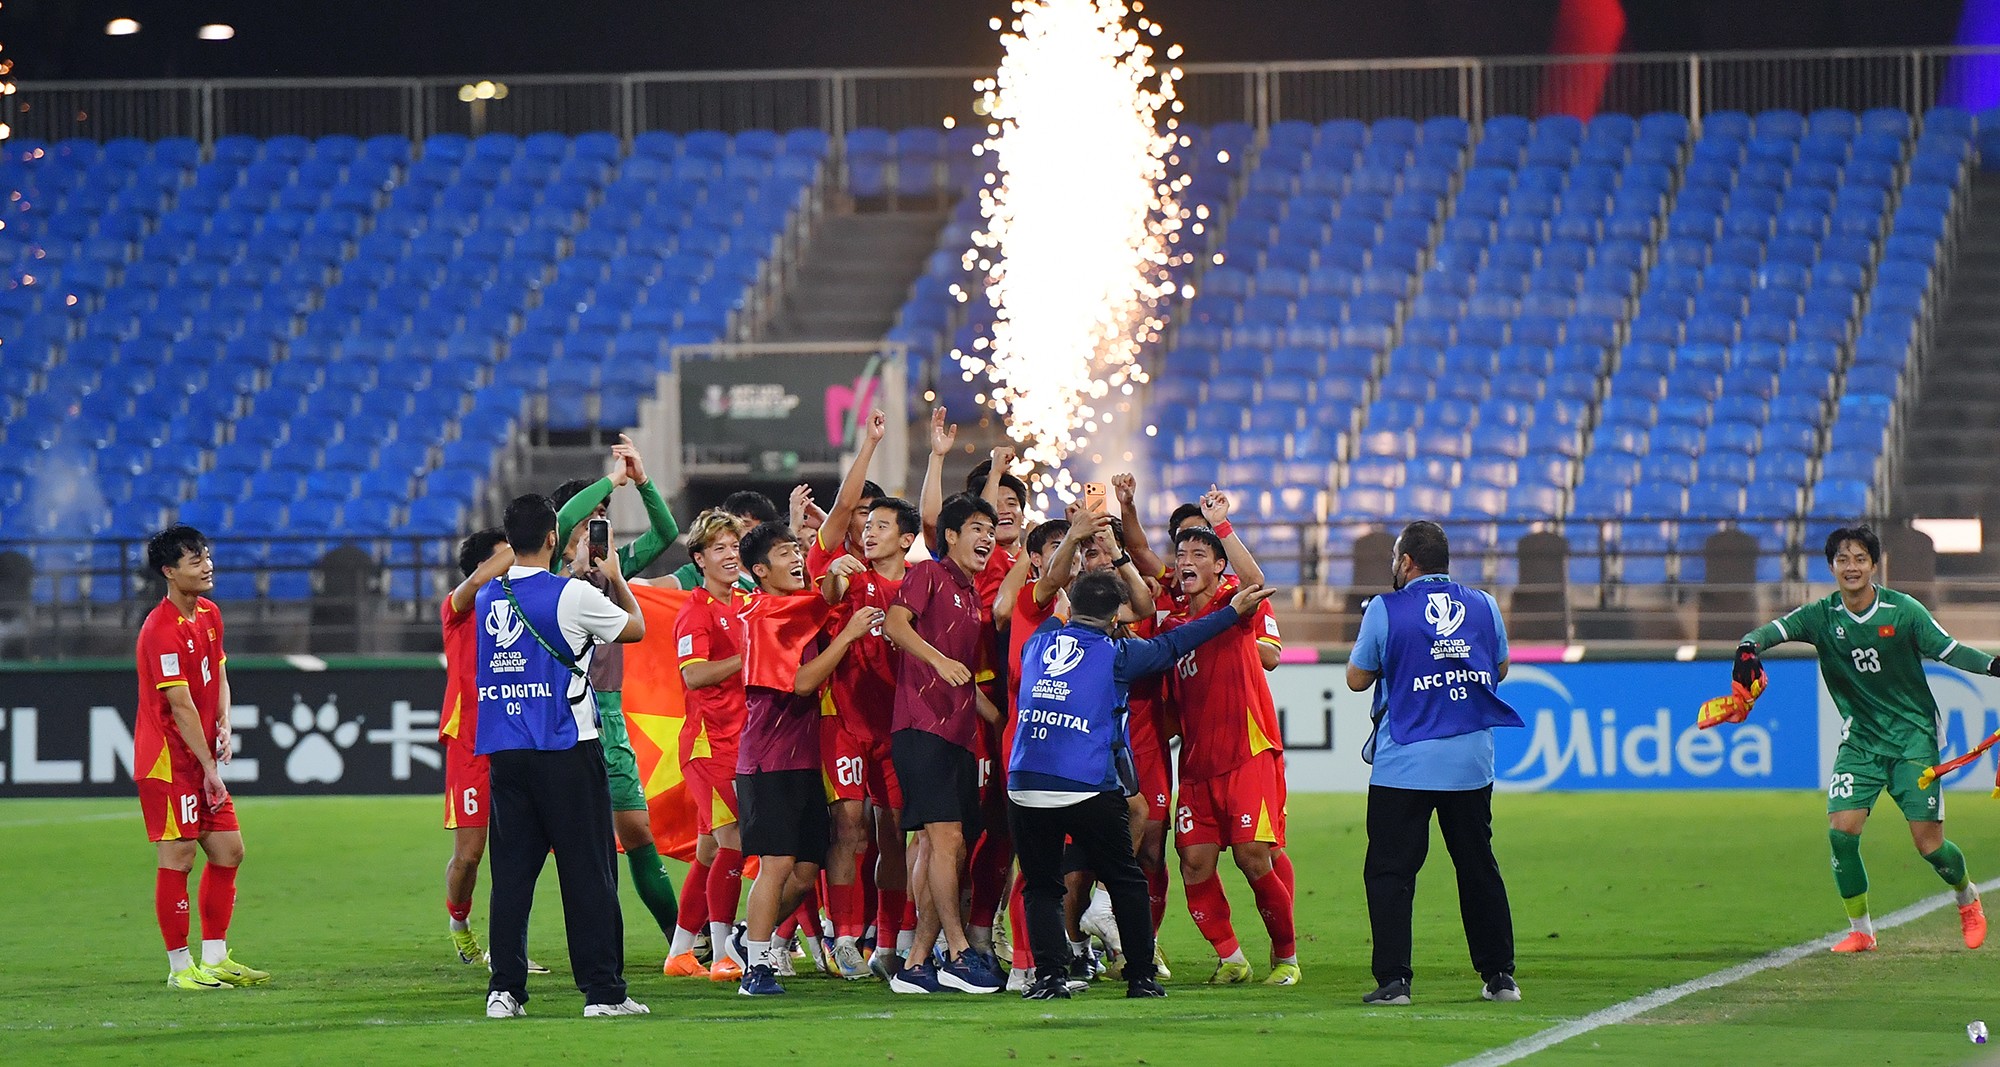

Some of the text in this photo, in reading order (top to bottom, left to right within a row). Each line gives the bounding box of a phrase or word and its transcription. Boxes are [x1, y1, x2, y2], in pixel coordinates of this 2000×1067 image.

[1430, 646, 1455, 655] ASIAN
[1433, 639, 1449, 647] AFC
[489, 658, 527, 668] ASIAN CUP
[493, 651, 522, 660] AFC U23
[1851, 647, 1881, 673] 23
[478, 682, 552, 702] FC DIGITAL
[1031, 686, 1071, 696] ASIAN CUP
[1036, 679, 1068, 688] AFC U23
[1412, 673, 1443, 692] AFC
[1449, 686, 1468, 701] 03
[506, 701, 521, 716] 09
[1018, 709, 1091, 734] FC DIGITAL
[366, 699, 442, 781] 卡
[1030, 726, 1048, 740] 10
[1503, 708, 1773, 778] Midea
[836, 755, 864, 787] 20
[1828, 773, 1855, 799] 23
[181, 793, 198, 824] 12
[463, 786, 479, 816] 6
[1176, 805, 1194, 834] 2
